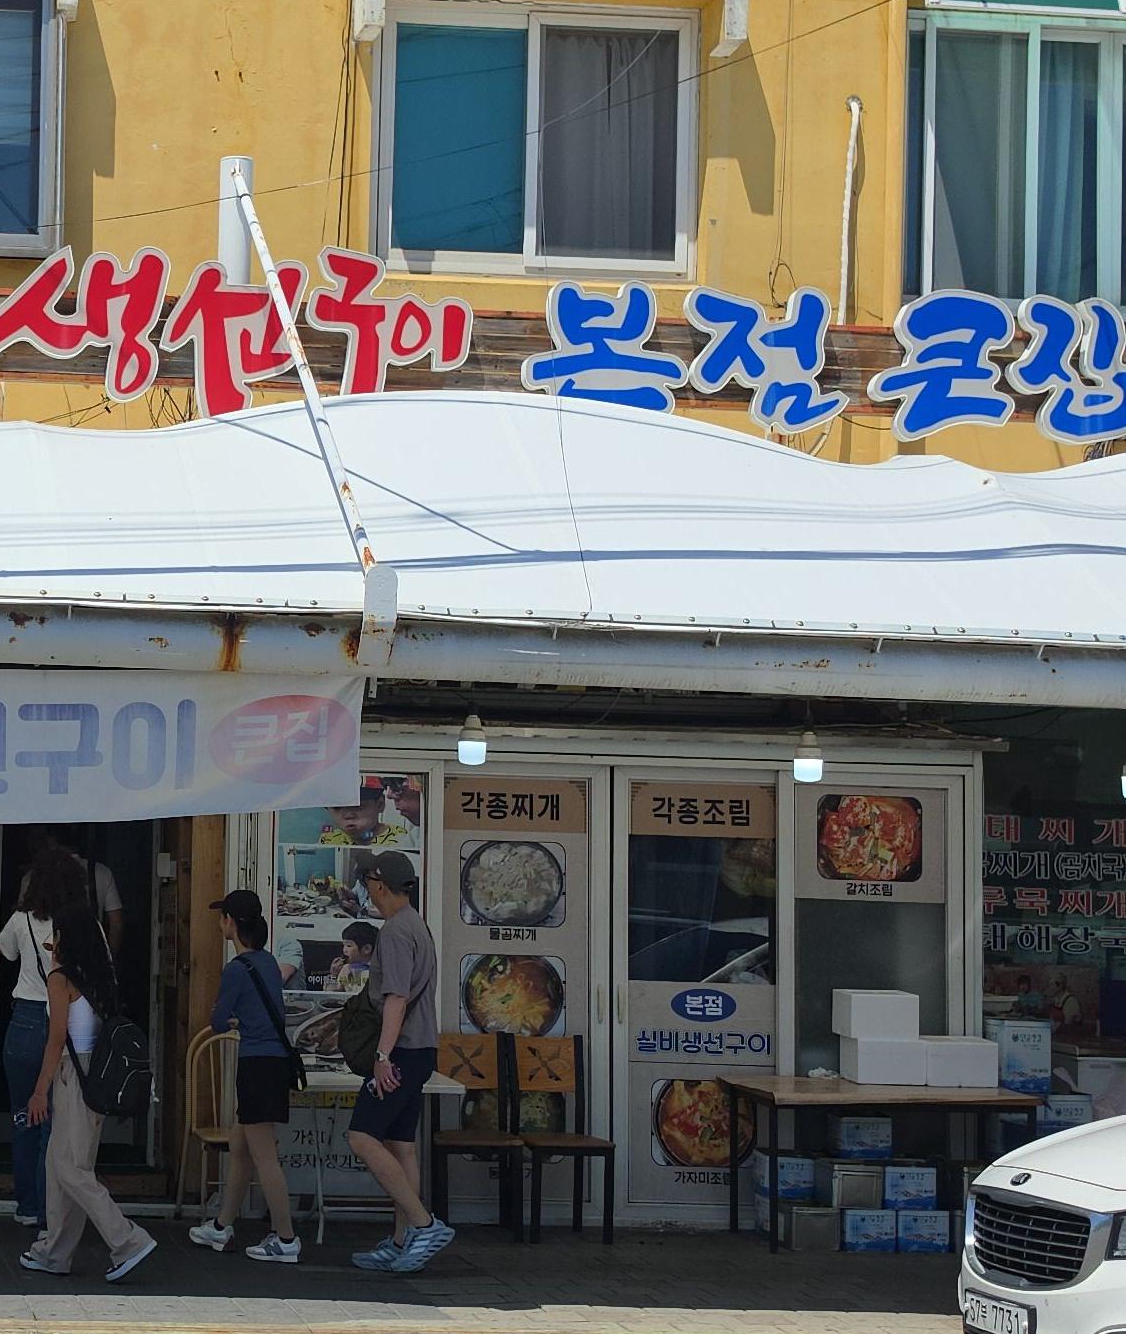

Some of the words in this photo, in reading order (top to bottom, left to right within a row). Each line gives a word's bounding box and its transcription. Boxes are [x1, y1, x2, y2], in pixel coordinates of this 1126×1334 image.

[521, 279, 849, 435] 본점
[867, 289, 1126, 444] 큰집
[232, 705, 330, 765] 큰집
[461, 792, 560, 821] 각종찌개
[652, 797, 750, 827] 각종조림
[846, 882, 893, 896] 갈치조림
[685, 994, 724, 1016] 본점
[637, 1030, 771, 1056] 실비생선구이
